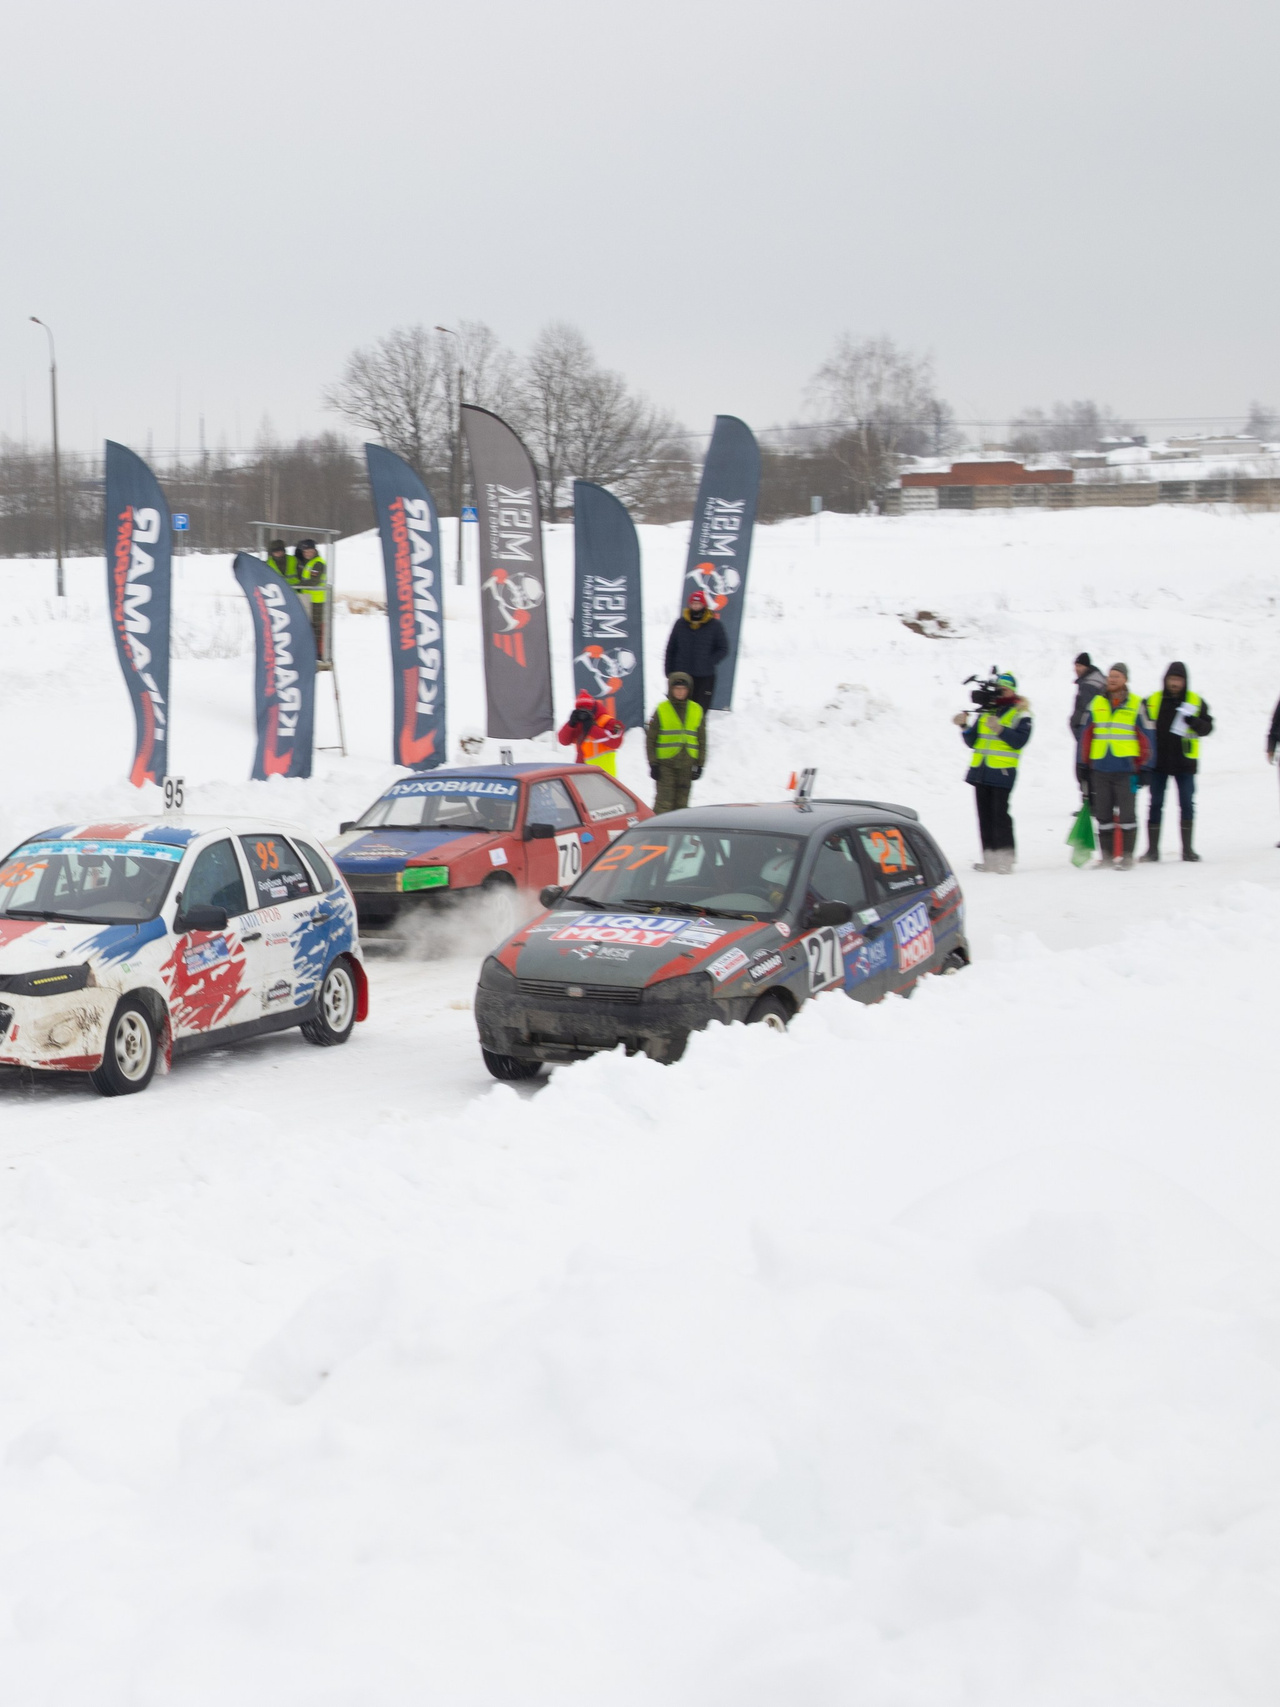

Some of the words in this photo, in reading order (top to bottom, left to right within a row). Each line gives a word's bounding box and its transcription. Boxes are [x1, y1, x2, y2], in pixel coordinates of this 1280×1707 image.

[175, 515, 187, 529] P
[165, 779, 184, 809] 95
[384, 780, 518, 797] ЛУХОВИЦЫ
[256, 840, 279, 871] 95
[558, 842, 580, 878] 70
[591, 845, 669, 872] 27
[870, 829, 908, 874] 27
[556, 927, 674, 944] MOLY
[577, 915, 687, 932] LIQUI
[895, 904, 930, 946] LIQUI
[808, 928, 835, 987] 27
[900, 929, 934, 968] MOLY
